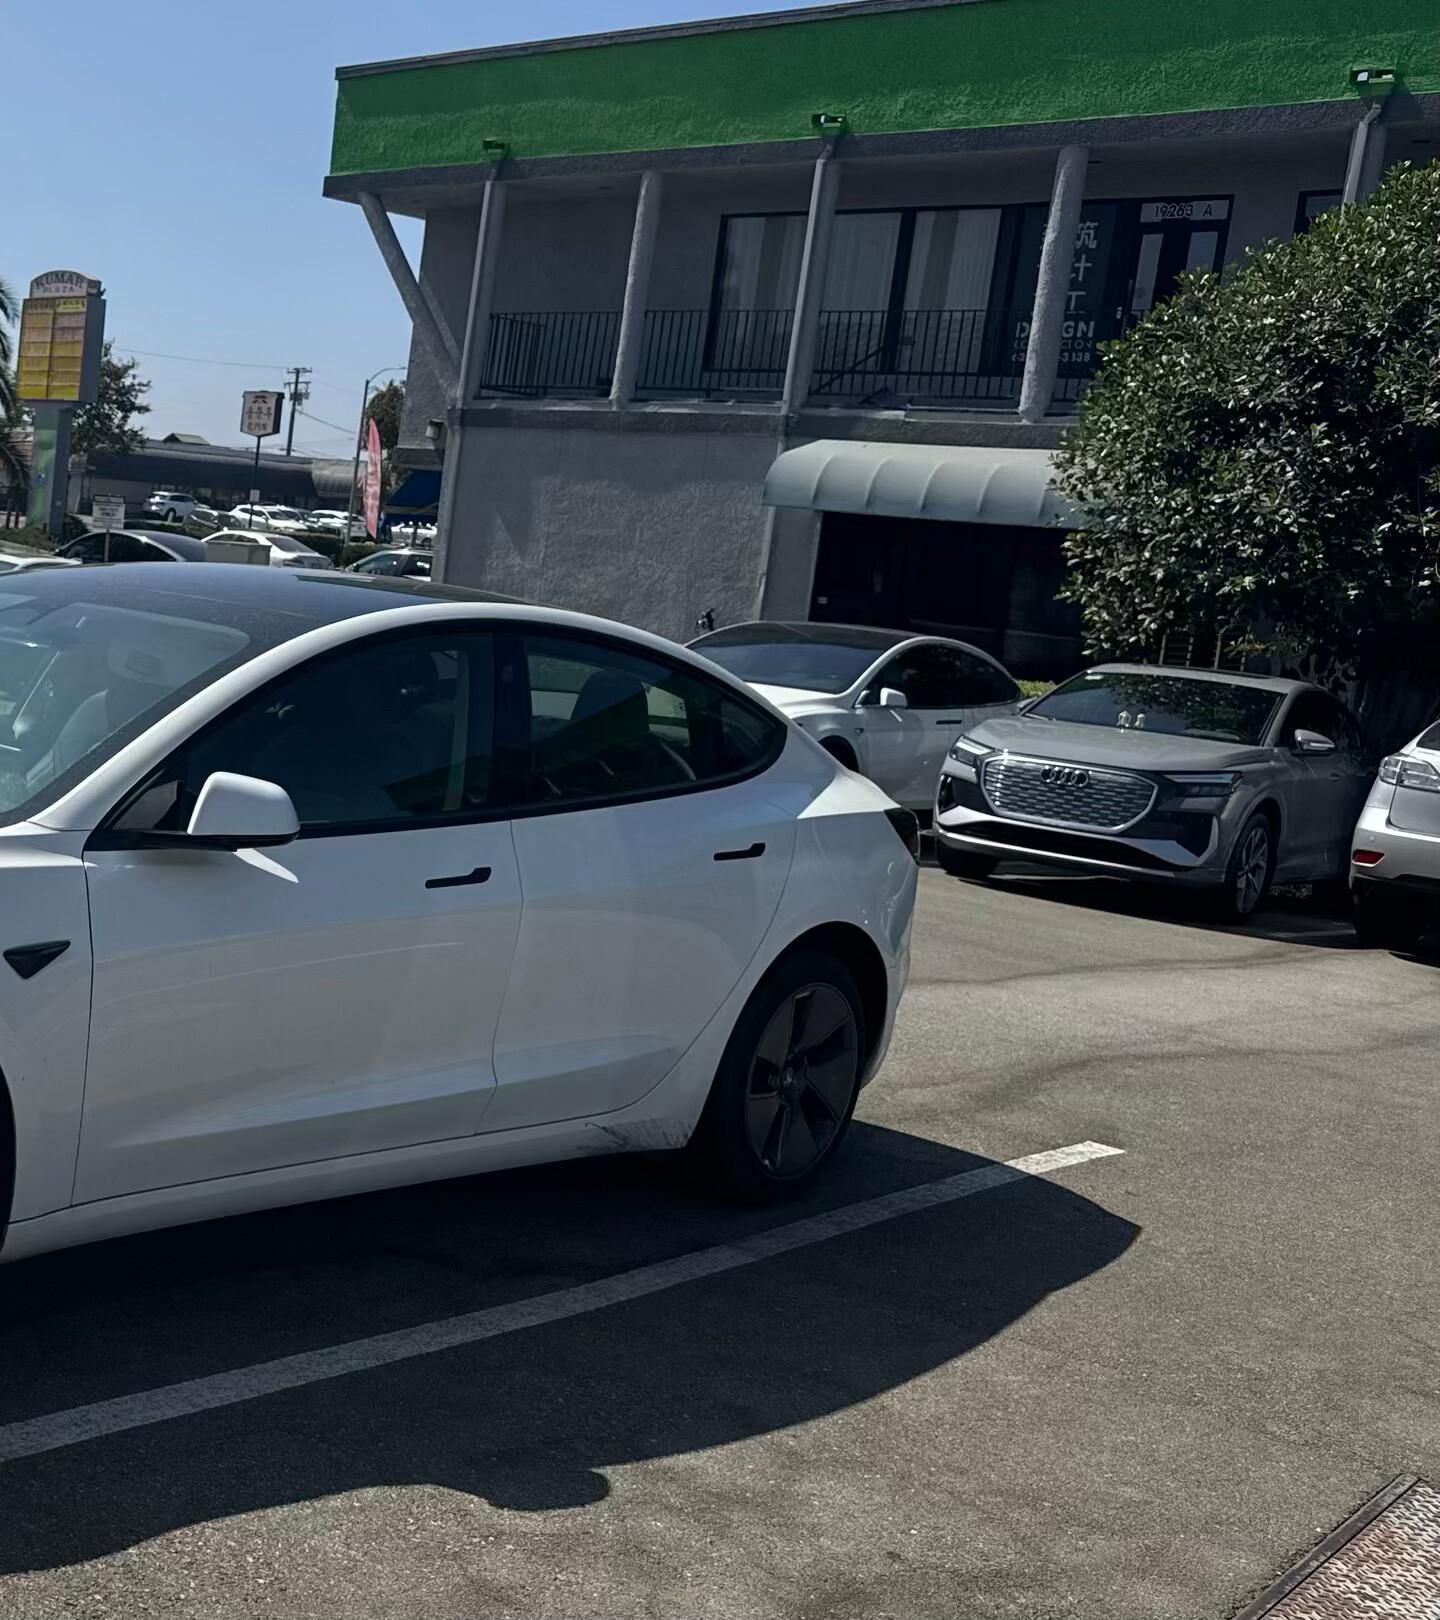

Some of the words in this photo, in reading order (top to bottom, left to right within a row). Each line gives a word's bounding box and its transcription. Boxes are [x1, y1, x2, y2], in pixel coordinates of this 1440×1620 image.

[1155, 204, 1193, 217] 19263
[1203, 204, 1212, 217] A
[1015, 321, 1095, 338] DGN
